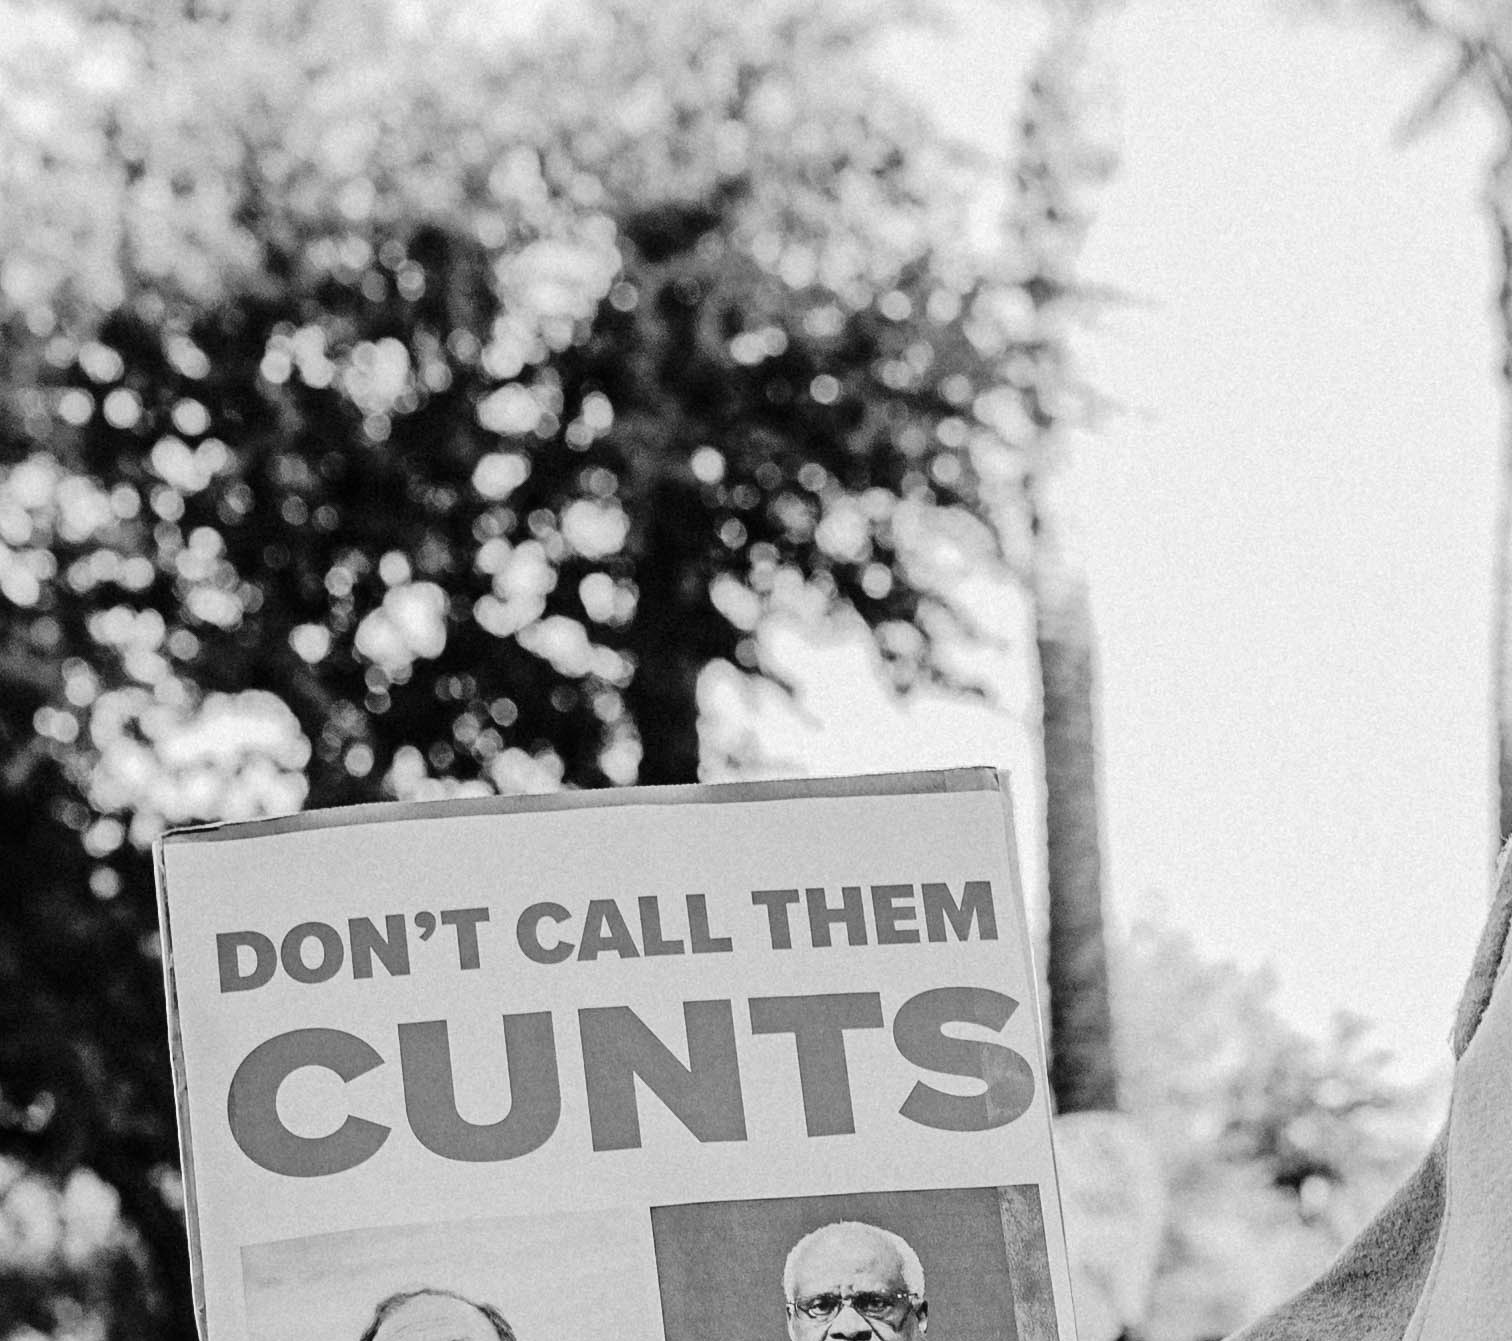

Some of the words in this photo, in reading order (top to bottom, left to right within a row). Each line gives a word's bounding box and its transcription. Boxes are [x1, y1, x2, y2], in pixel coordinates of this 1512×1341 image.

[216, 904, 491, 993] DON’T
[515, 892, 733, 966] CALL
[751, 879, 1000, 950] THEM
[226, 986, 1036, 1178] CUNTS
